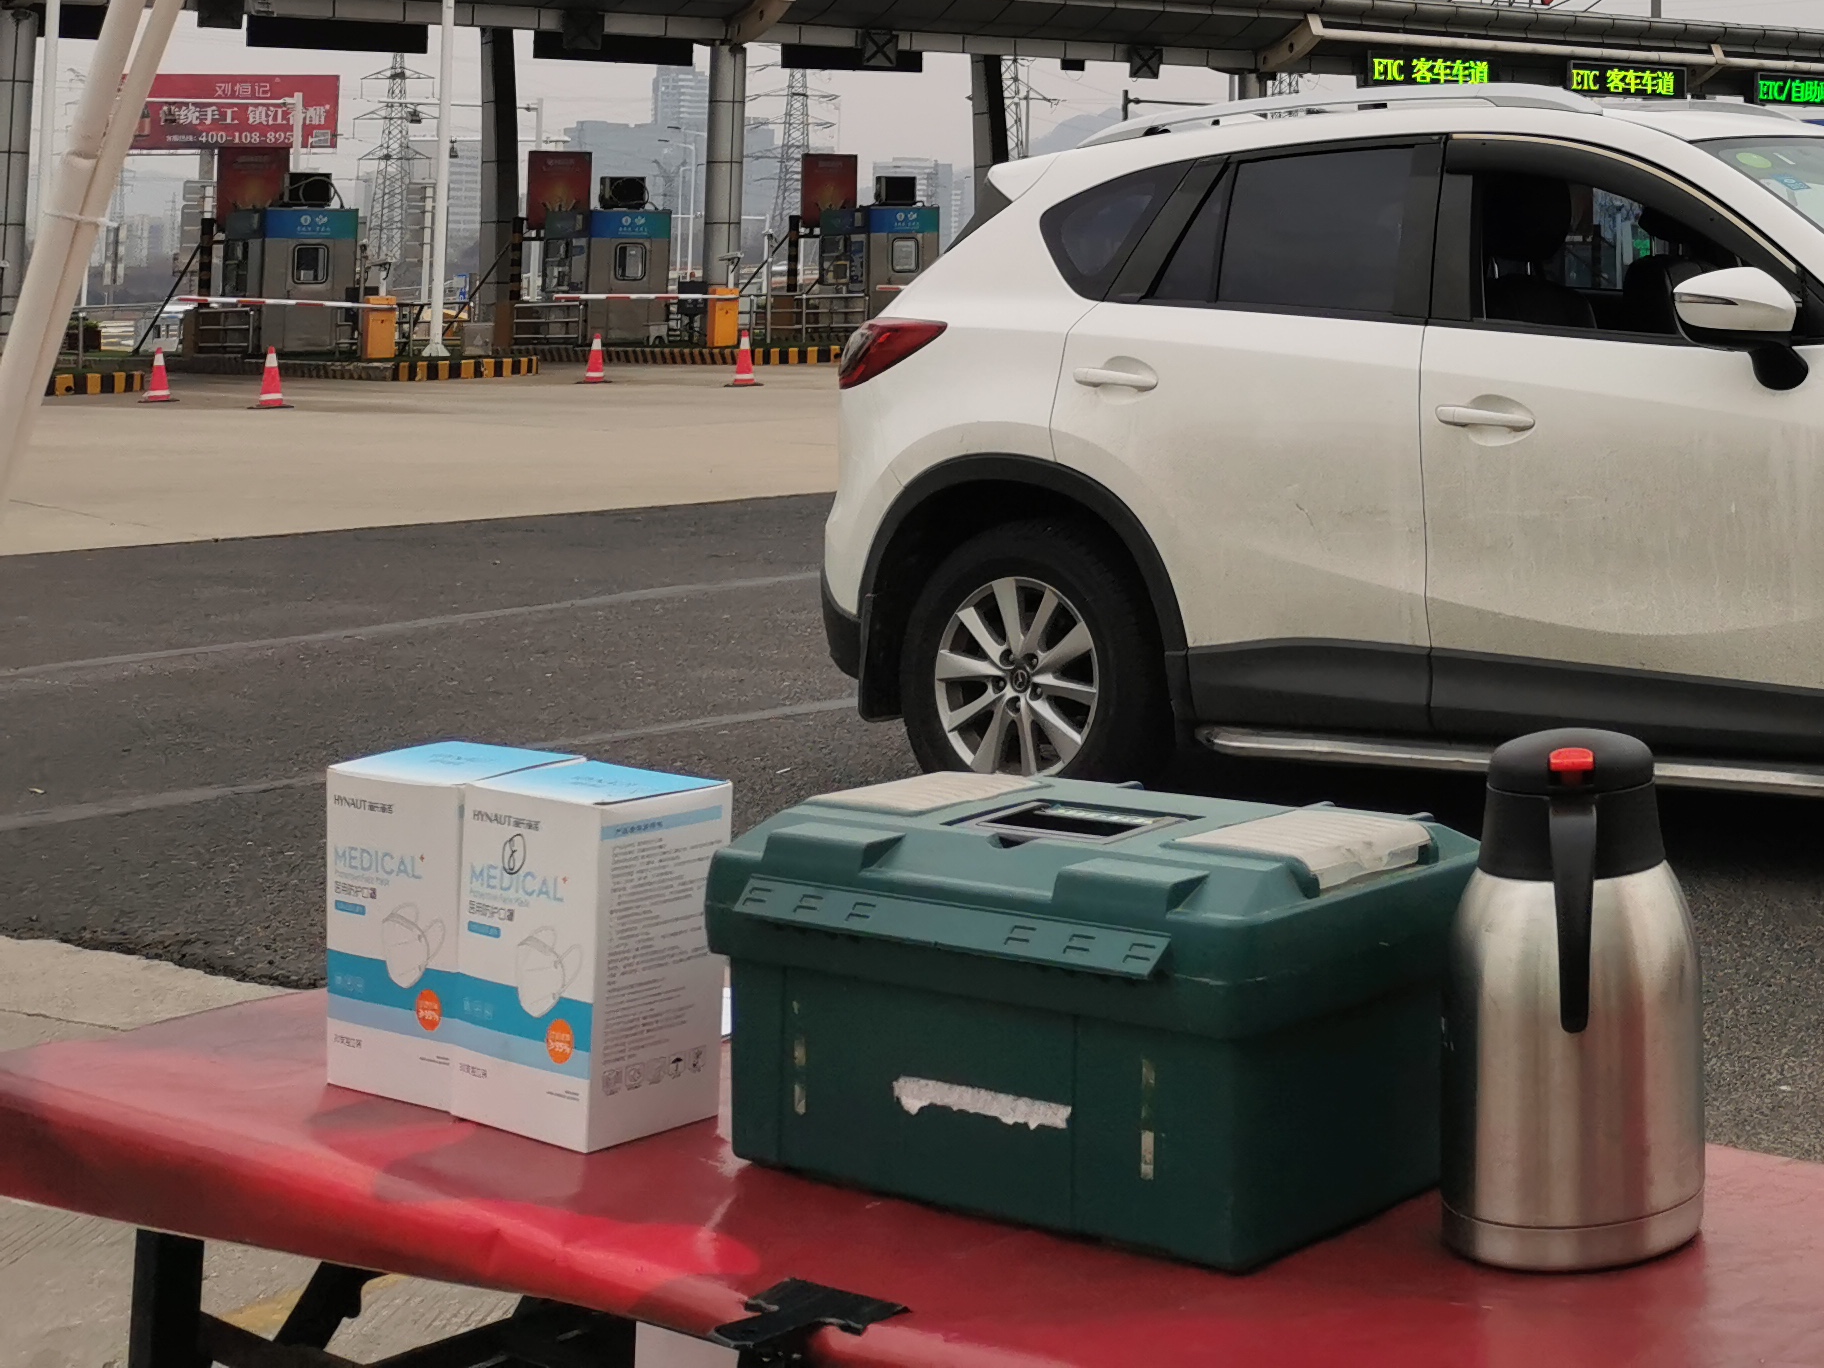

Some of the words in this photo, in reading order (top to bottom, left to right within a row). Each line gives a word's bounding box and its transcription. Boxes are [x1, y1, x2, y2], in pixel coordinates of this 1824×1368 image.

[1373, 58, 1405, 81] ETC
[1412, 57, 1489, 85] 客车车道
[1571, 69, 1600, 91] ETC
[1606, 68, 1675, 95] 客车车道
[214, 82, 271, 98] 刘恒记
[199, 131, 302, 144] 400-108-895
[334, 845, 423, 880] MEDICAL
[470, 862, 565, 903] MEDICAL
